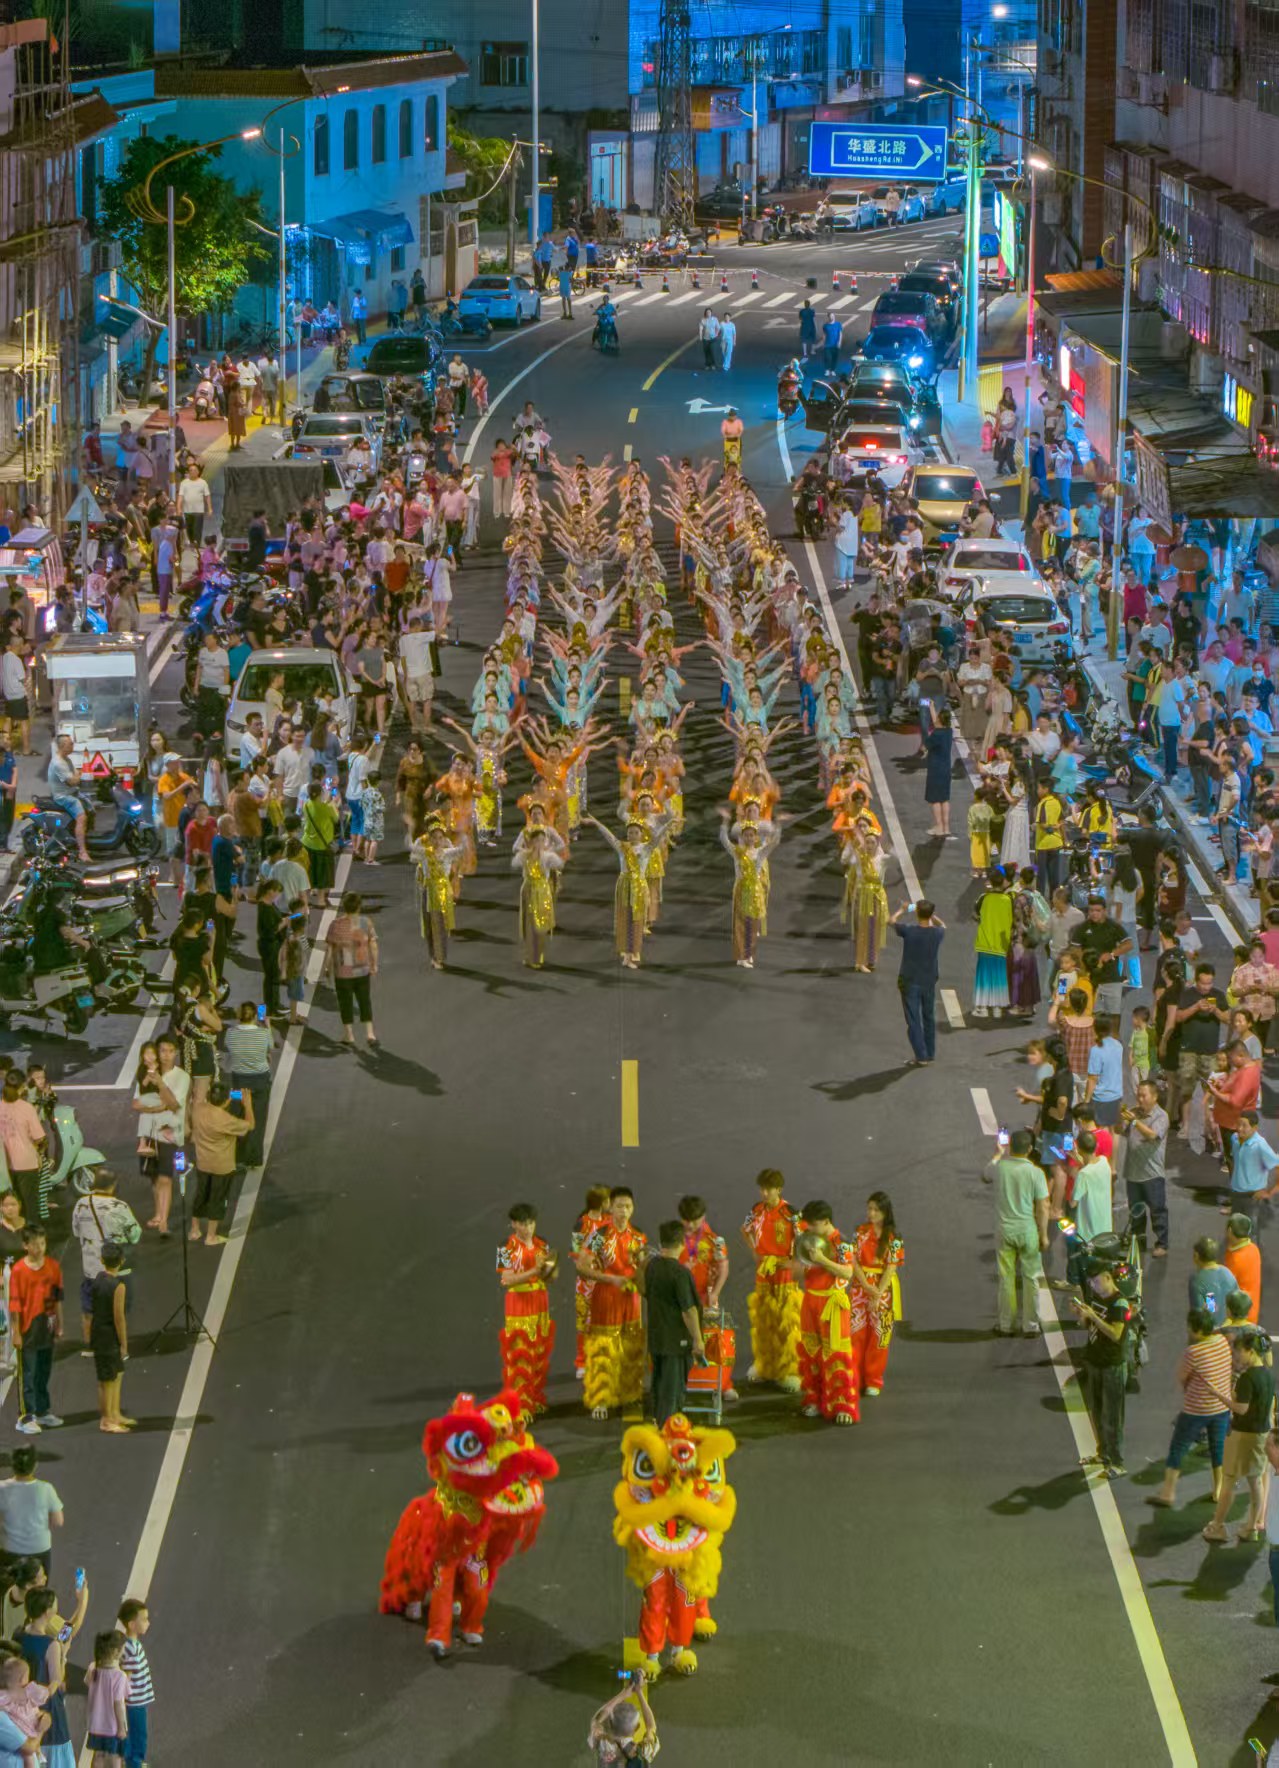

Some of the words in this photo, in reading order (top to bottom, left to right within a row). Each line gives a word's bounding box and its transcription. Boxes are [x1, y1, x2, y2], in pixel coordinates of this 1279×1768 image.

[848, 138, 906, 155] 华盛北路
[848, 155, 881, 164] Huasheng
